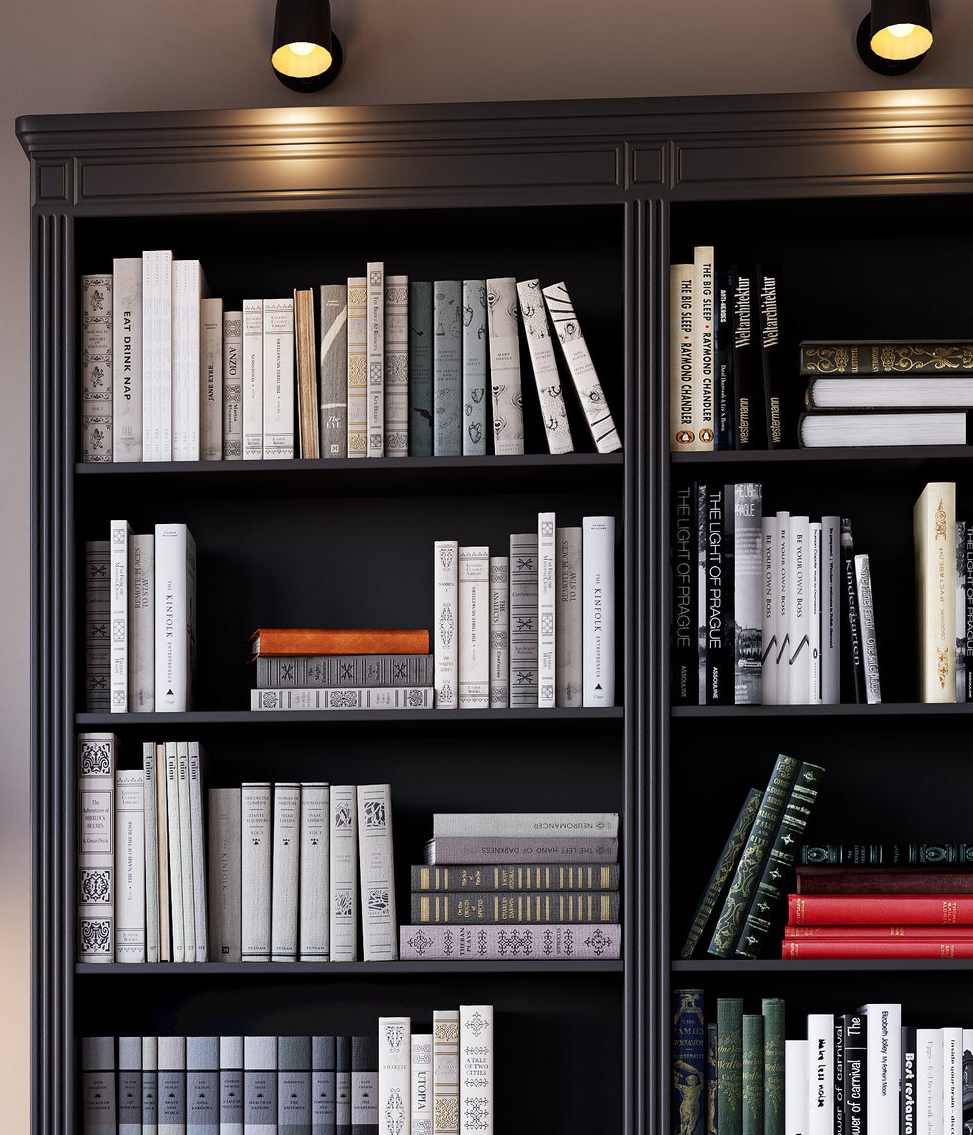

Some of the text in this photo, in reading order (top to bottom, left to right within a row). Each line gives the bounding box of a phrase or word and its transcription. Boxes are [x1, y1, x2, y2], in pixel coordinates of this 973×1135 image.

[681, 279, 693, 333] THE BIG SLEEP
[702, 263, 712, 322] THE BIG SLEEP
[735, 277, 750, 349] Weltarchitektur
[763, 276, 779, 349] Weltarchitektur
[123, 311, 132, 401] EAT DRINK NAP
[228, 346, 237, 376] ANZIO
[207, 364, 215, 402] JANE EYRE
[680, 343, 693, 425] RAYMOND CHANDLER
[702, 332, 712, 422] RAYMOND CHANDLER
[740, 398, 749, 444] westermann
[766, 534, 772, 545] BE
[796, 534, 804, 544] BE
[709, 491, 722, 649] THE LIGHT OF PRAGUE
[142, 598, 149, 608] TO
[594, 588, 602, 632] KINFOLK
[796, 598, 804, 618] BOSS
[845, 559, 860, 666] Kindergarten
[847, 1017, 861, 1036] The
[834, 1025, 843, 1081] carnival
[905, 1053, 915, 1079] Best
[417, 1072, 426, 1110] UTOPIA
[834, 1084, 843, 1102] of
[847, 1060, 861, 1099] carnival
[847, 1101, 861, 1113] of
